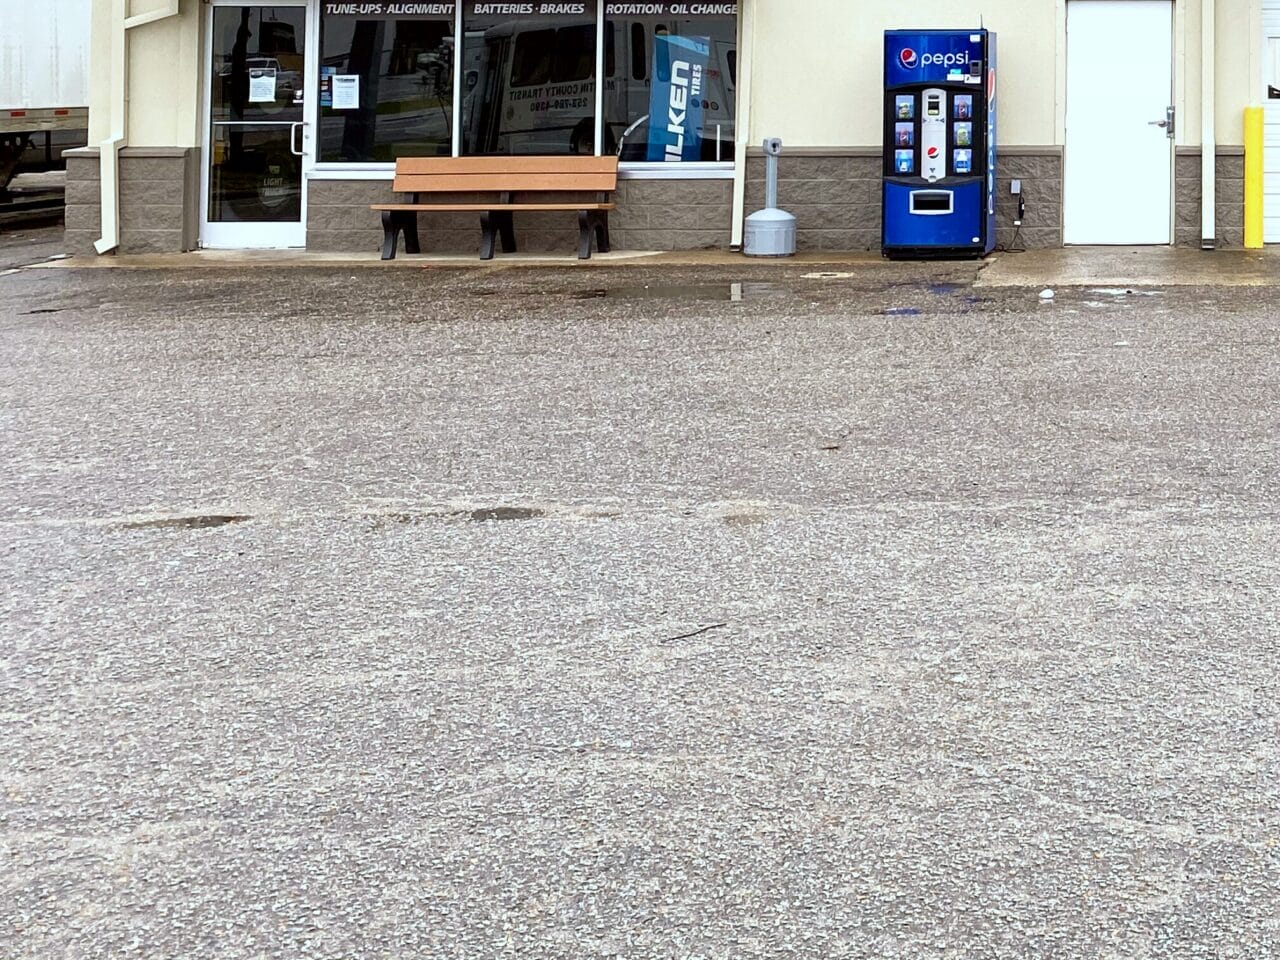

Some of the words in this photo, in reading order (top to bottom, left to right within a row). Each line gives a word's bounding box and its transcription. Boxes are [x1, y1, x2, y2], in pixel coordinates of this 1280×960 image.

[326, 3, 382, 15] TUNE-UPS
[386, 3, 455, 15] ALIGNMENT
[473, 3, 533, 15] BATTERIES
[539, 3, 585, 15] BRAKES
[606, 3, 664, 15] ROTATION
[670, 3, 688, 15] OIL
[921, 50, 968, 68] pepsi
[690, 63, 702, 96] TIRES
